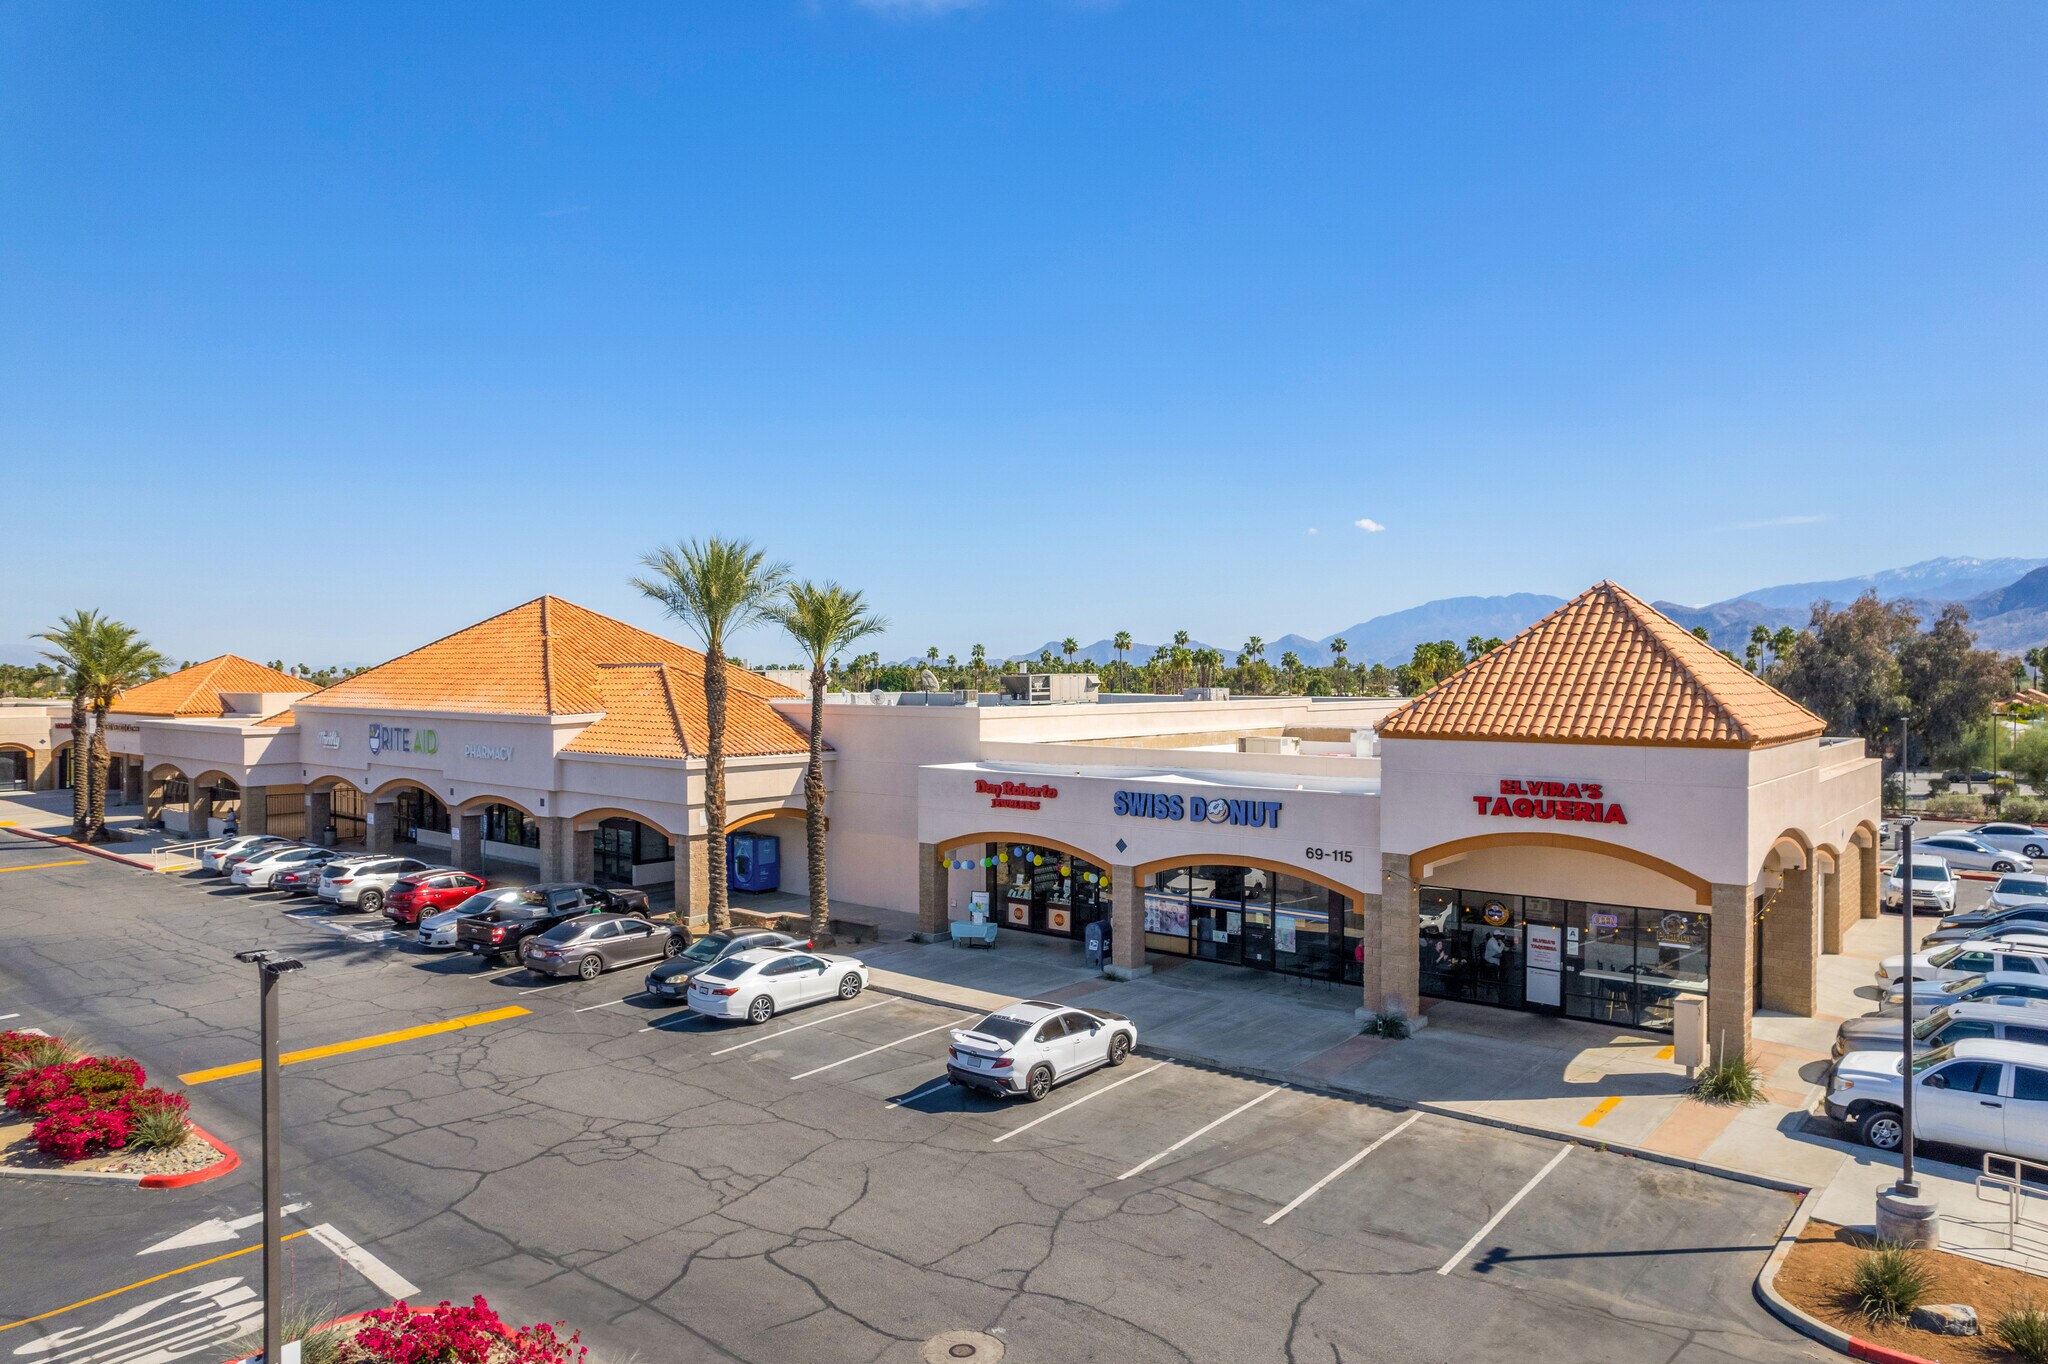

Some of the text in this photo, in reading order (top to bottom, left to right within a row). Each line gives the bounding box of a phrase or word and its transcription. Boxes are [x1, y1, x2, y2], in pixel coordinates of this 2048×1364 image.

[319, 731, 341, 750] Thrifty
[382, 727, 439, 755] RITE AID
[464, 745, 514, 761] PHARMACY
[975, 779, 1058, 799] Don Roberto
[1500, 779, 1603, 799] ELVIRA'S
[991, 799, 1041, 810] JEWELERS
[1113, 790, 1283, 829] SWISS DONUT
[1473, 795, 1628, 825] TAQUERIA
[1306, 847, 1354, 863] 69-115
[1593, 916, 1617, 926] OPEN
